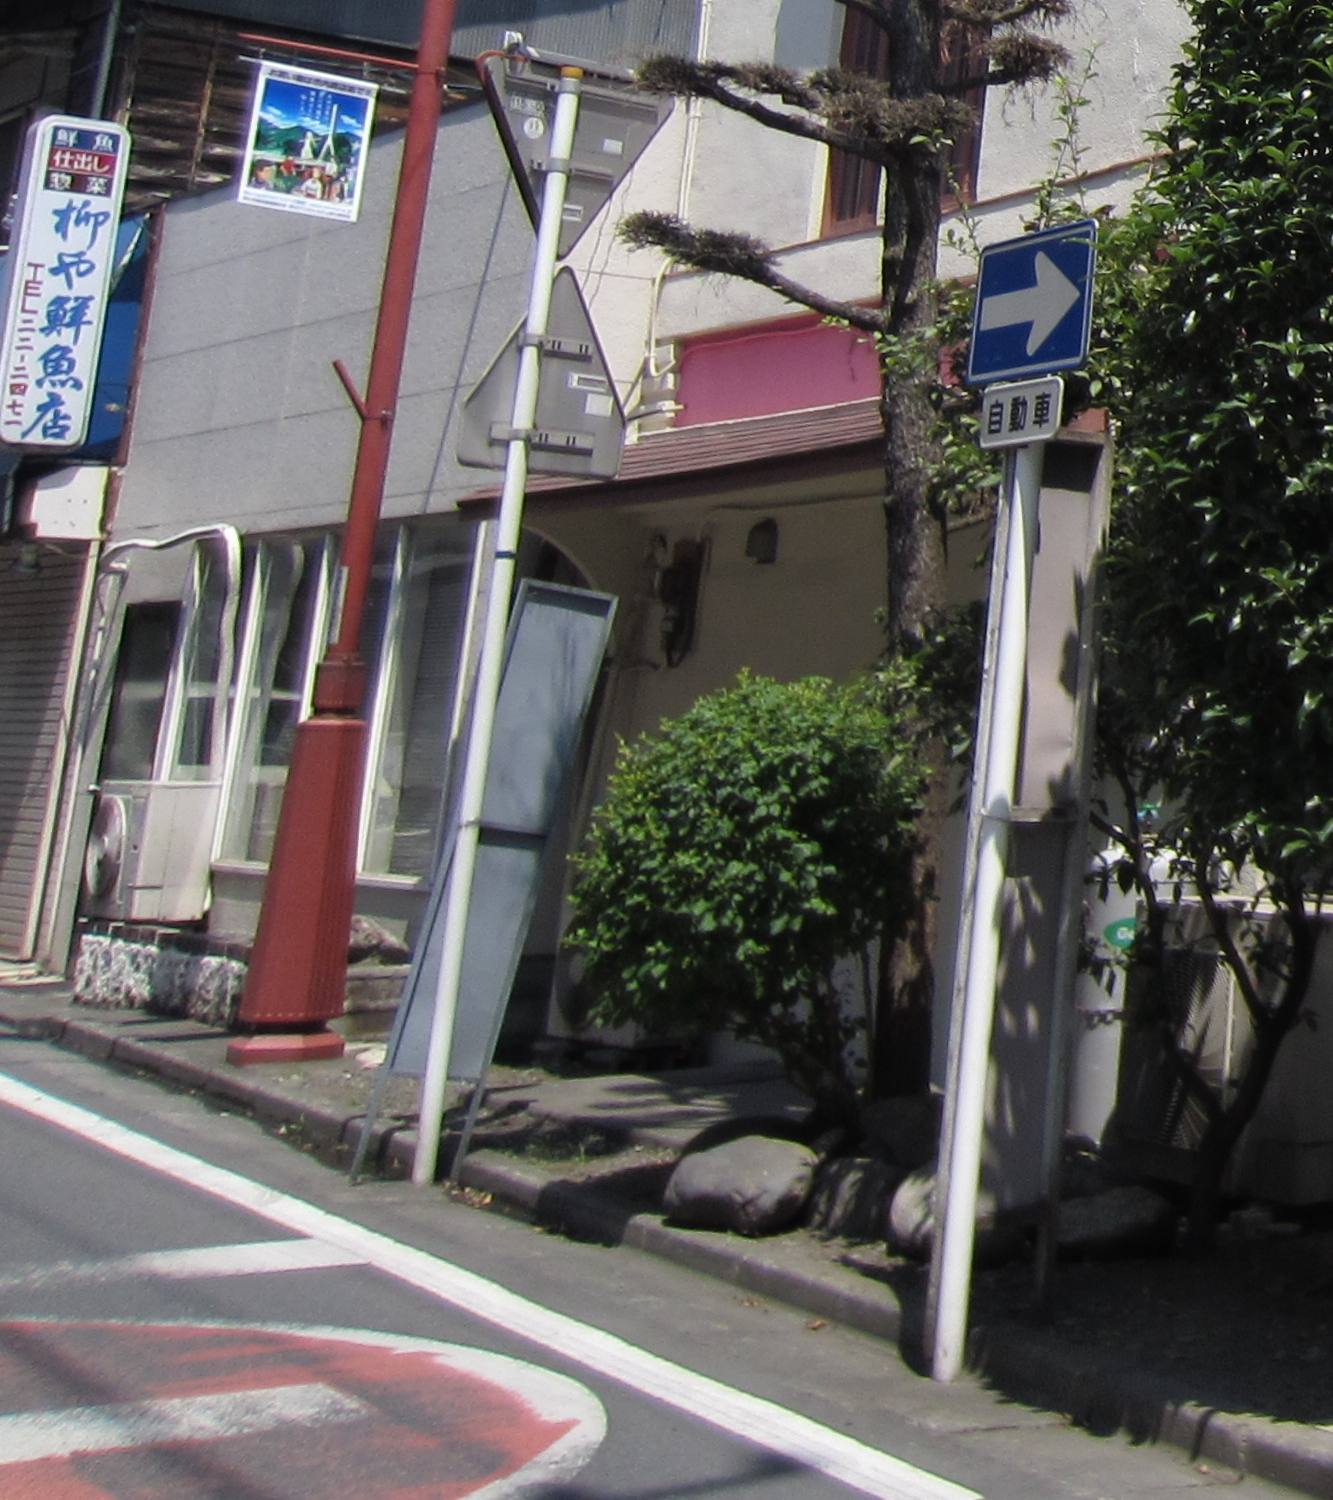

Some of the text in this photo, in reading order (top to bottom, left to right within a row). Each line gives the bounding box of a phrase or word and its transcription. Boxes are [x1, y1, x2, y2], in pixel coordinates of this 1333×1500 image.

[53, 150, 110, 173] 仕出し
[21, 197, 110, 441] 柳や鮮魚店
[988, 392, 1052, 434] 自動車
